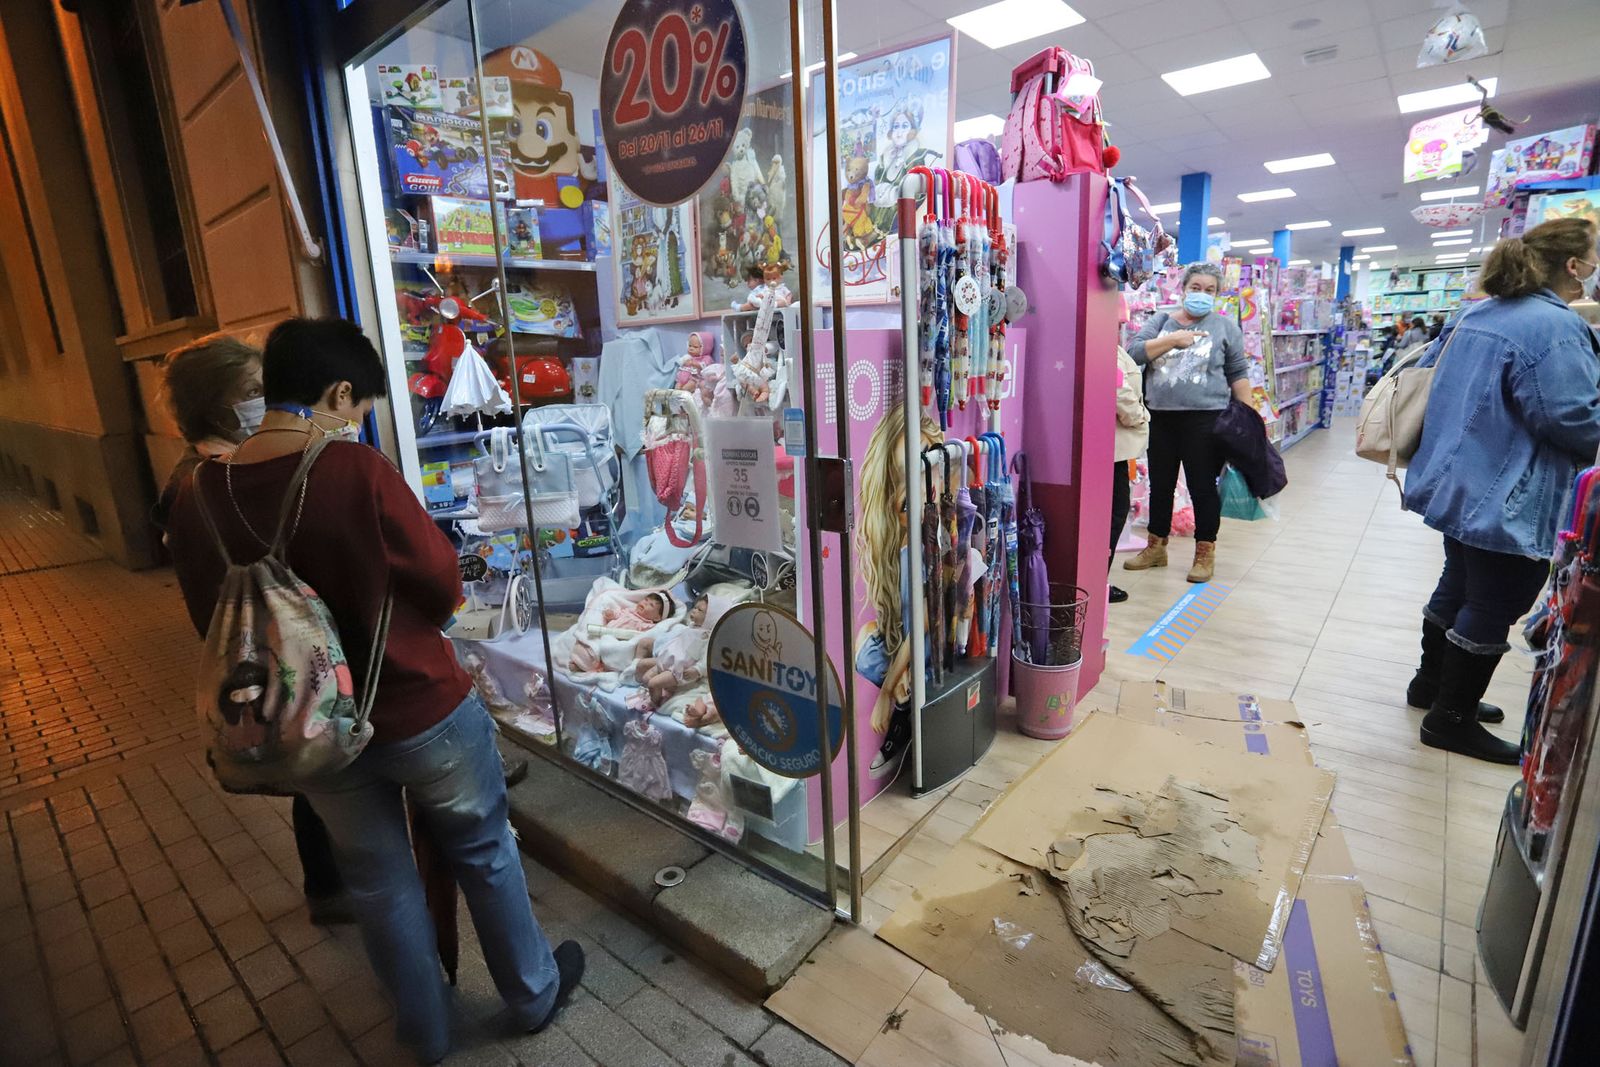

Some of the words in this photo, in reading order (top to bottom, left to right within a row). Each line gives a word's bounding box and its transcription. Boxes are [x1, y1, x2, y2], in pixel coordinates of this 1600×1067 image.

[618, 140, 638, 160] Del
[639, 129, 671, 153] 20/11
[673, 127, 686, 147] al
[688, 119, 724, 144] 26/11
[733, 468, 748, 483] 35
[721, 647, 817, 697] SANITOY
[734, 724, 777, 766] ESPACIO
[780, 749, 821, 771] SEGURO
[1296, 969, 1318, 1008] TOYS
